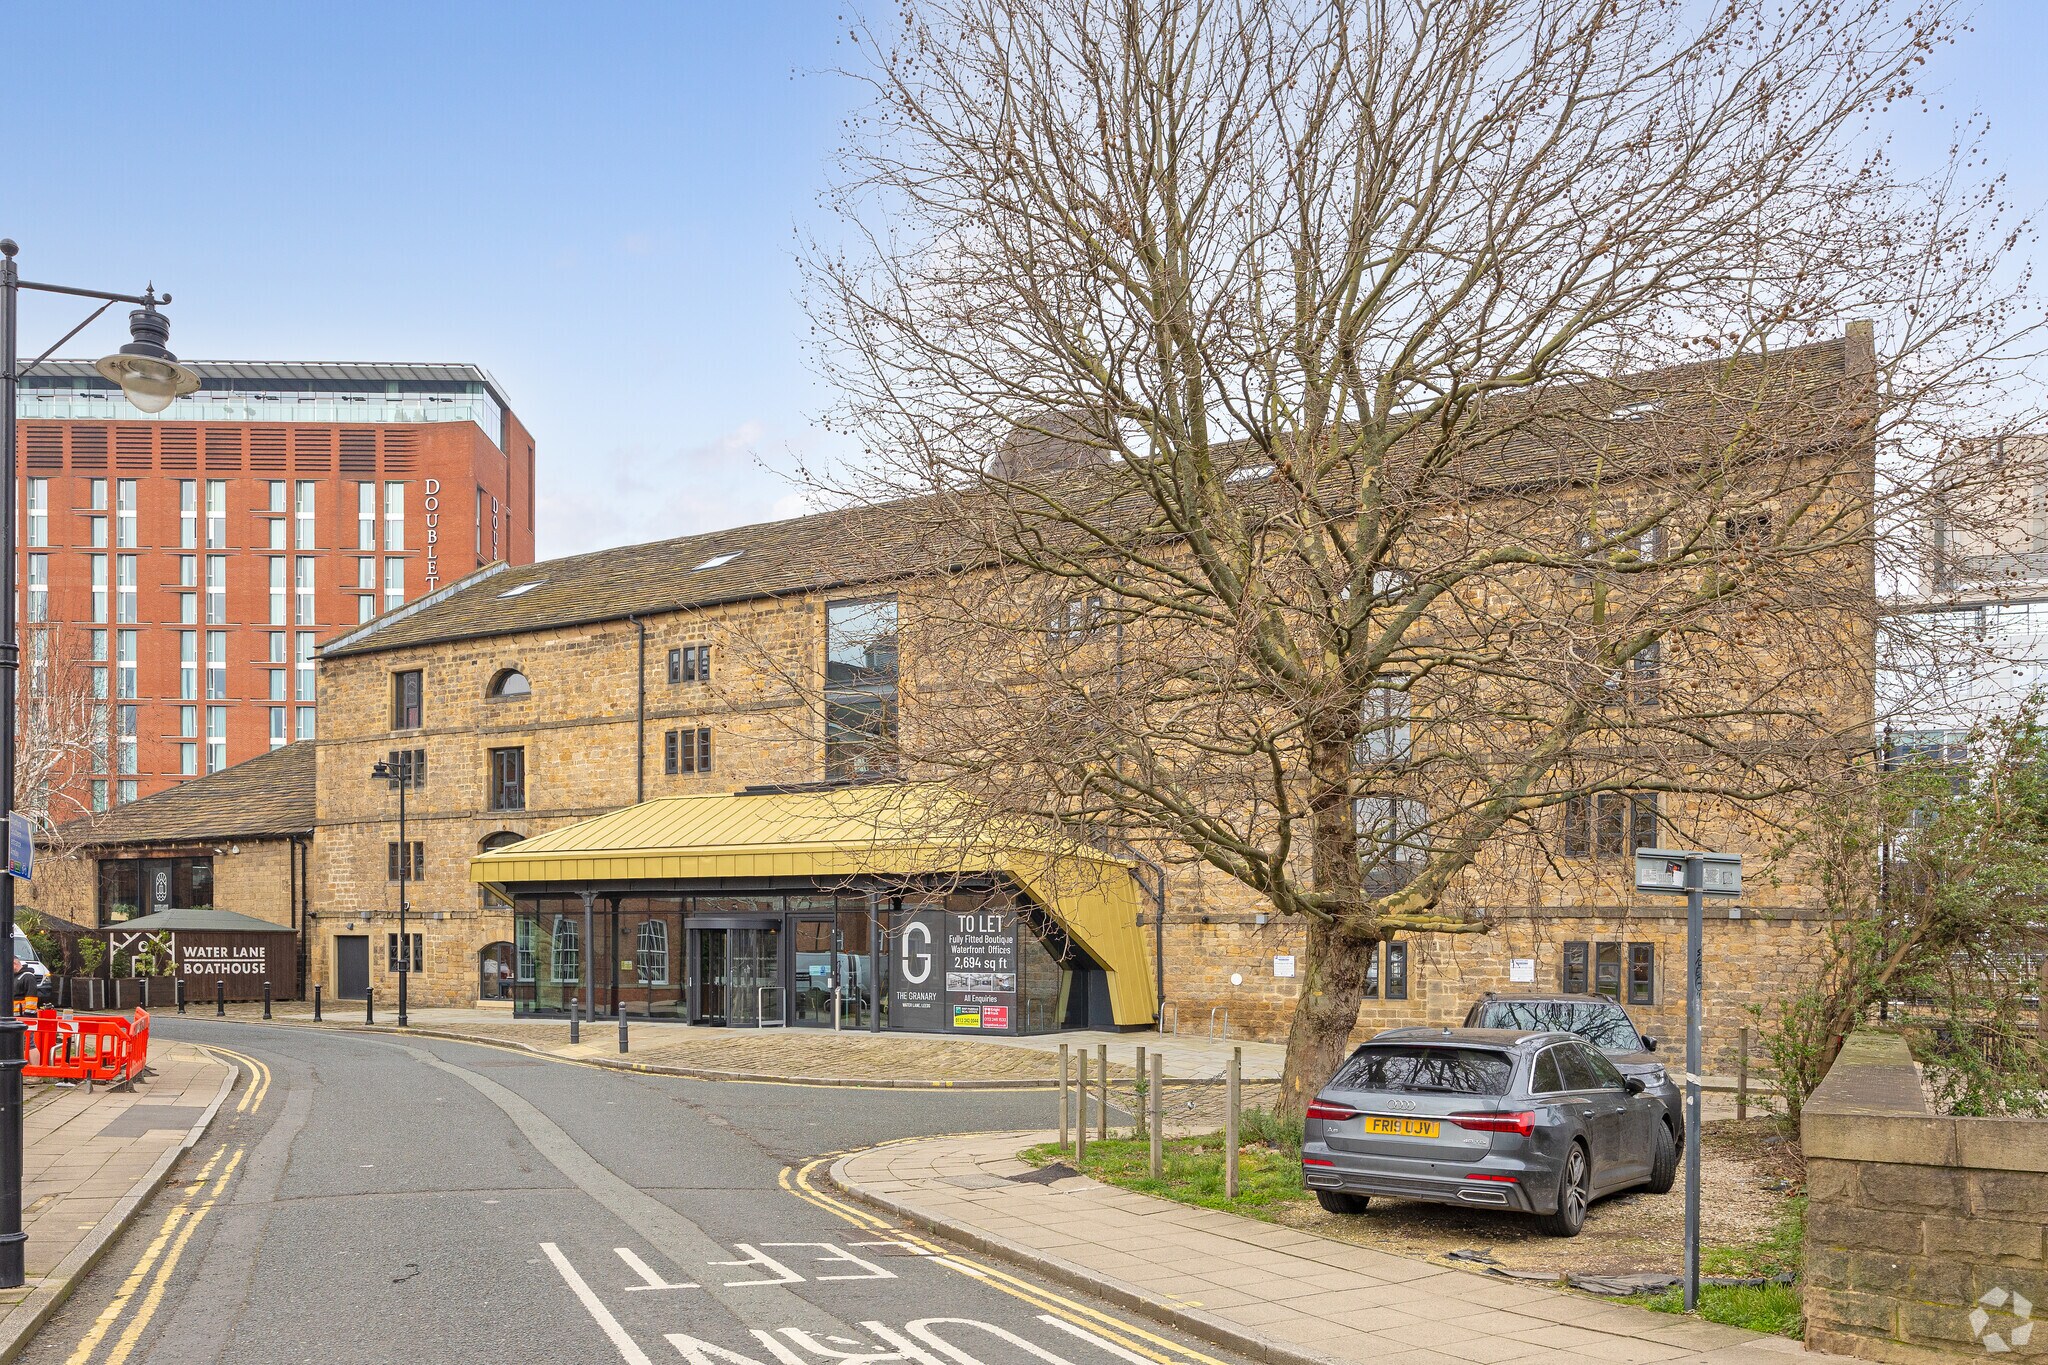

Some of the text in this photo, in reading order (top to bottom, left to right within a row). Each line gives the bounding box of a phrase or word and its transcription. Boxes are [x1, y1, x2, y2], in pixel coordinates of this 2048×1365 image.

[425, 479, 440, 592] DOUBLET
[957, 915, 1004, 933] TO LET
[949, 934, 1014, 946] Fully Fitted Boutique
[183, 946, 266, 958] WATER LANE
[951, 945, 1011, 954] Waterfront Offices
[183, 963, 266, 975] BOATHOUSE
[954, 956, 1008, 972] 2,694 sq ft
[896, 991, 937, 1001] THE GRANARY
[963, 994, 998, 1004] All Enquiries
[1373, 1119, 1402, 1133] FR19
